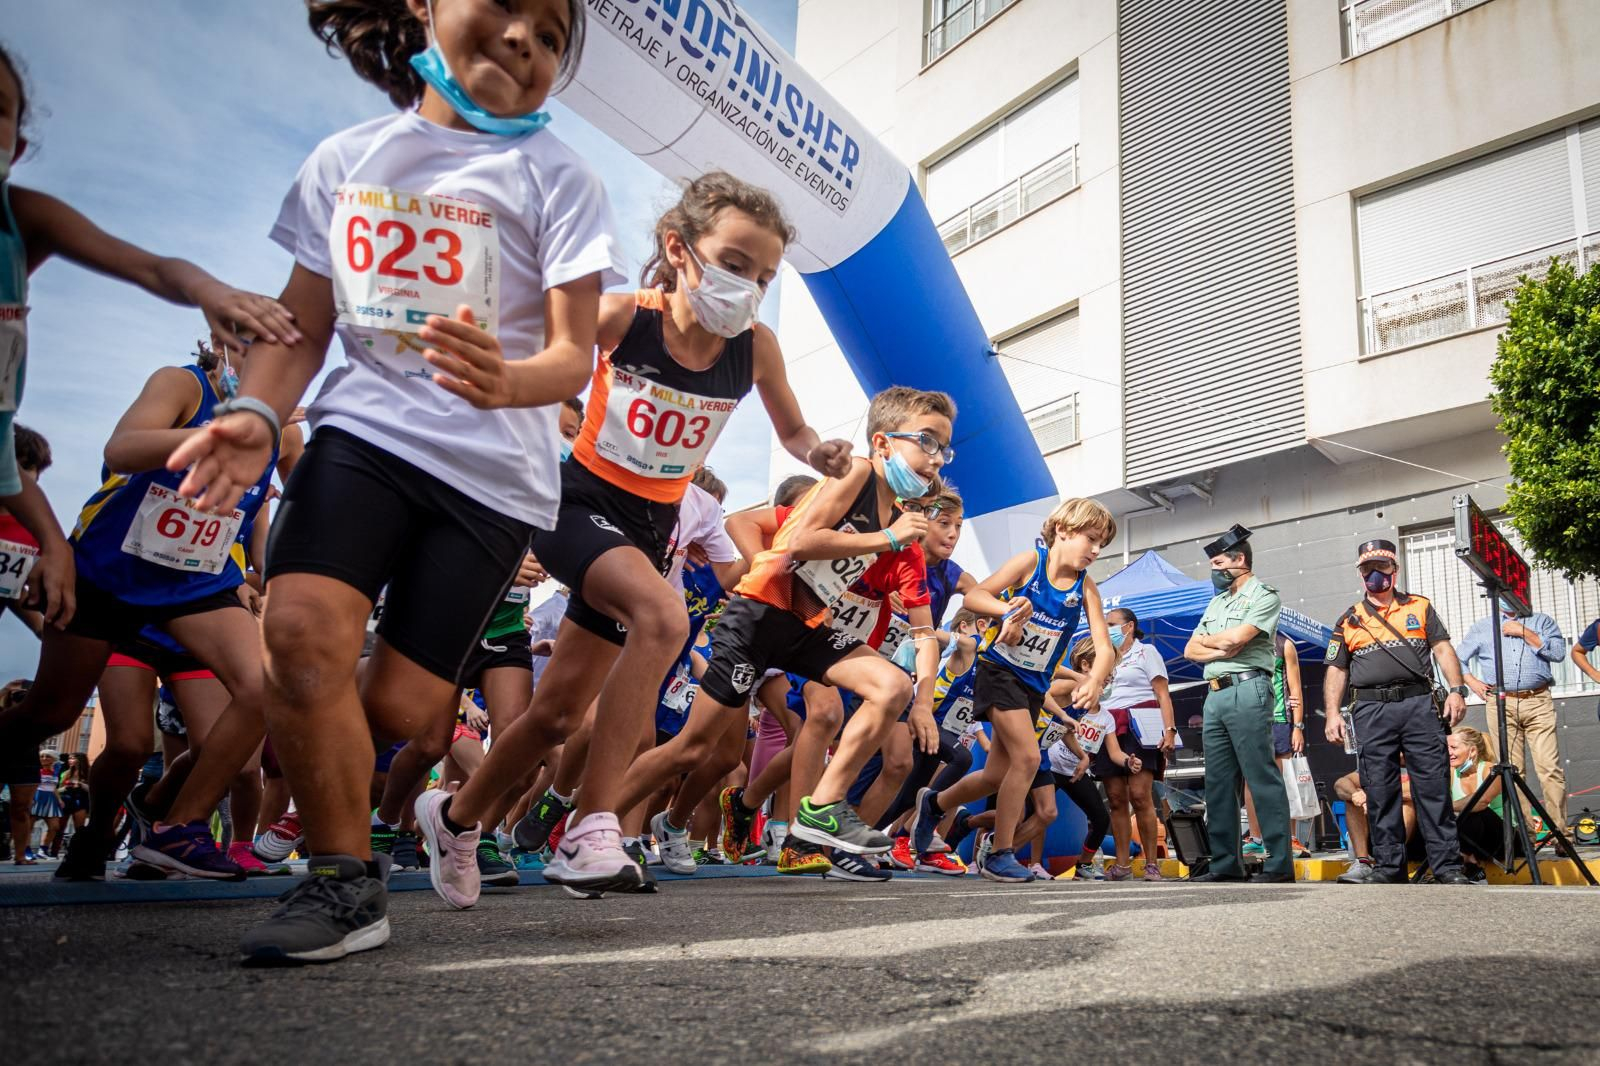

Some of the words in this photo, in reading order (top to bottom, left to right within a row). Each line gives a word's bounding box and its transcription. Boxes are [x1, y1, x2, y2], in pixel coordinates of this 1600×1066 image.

[664, 51, 677, 69] Y
[677, 64, 778, 155] ORGANIZACIÓN
[776, 146, 799, 169] DE
[795, 162, 850, 211] EVENTOS
[358, 191, 422, 215] MILLA
[429, 202, 492, 228] VERDE
[347, 215, 464, 286] 623
[378, 286, 420, 299] VIRGINIA
[650, 386, 695, 409] MILLA
[700, 400, 734, 412] VERDE
[627, 398, 710, 449] 603
[157, 507, 221, 546] 619
